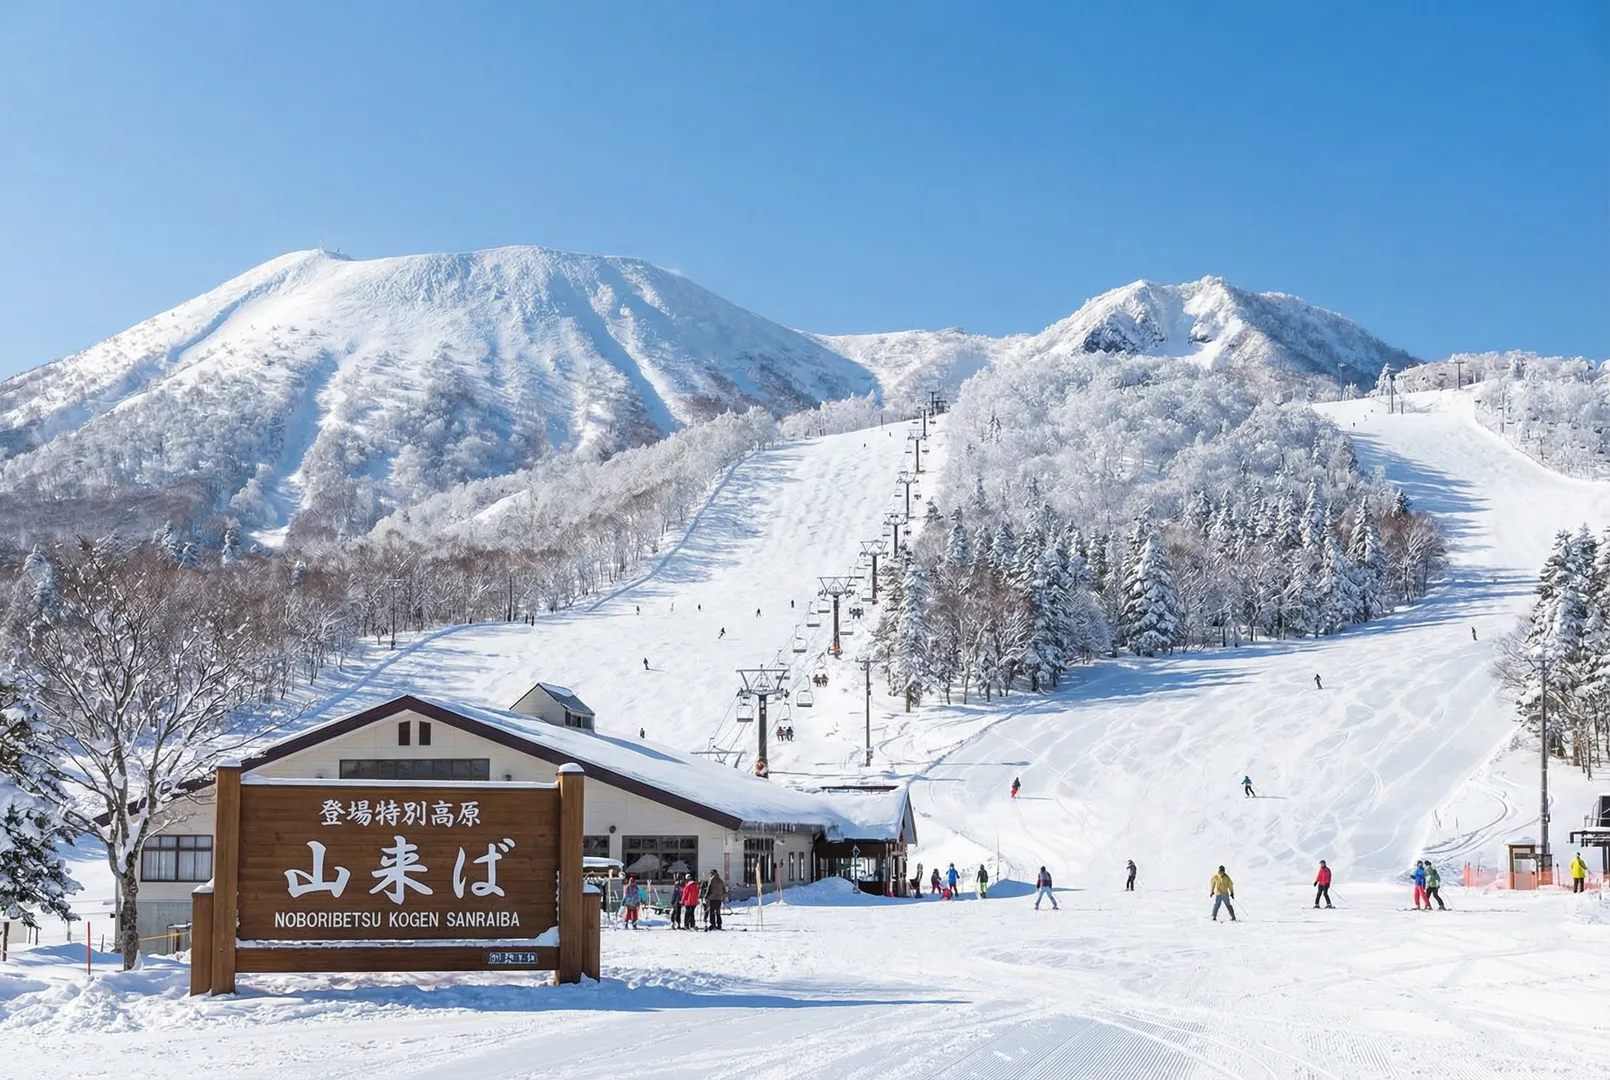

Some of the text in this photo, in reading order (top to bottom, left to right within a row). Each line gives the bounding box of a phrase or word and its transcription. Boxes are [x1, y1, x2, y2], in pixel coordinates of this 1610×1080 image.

[319, 799, 481, 828] 登場特別高原
[283, 835, 516, 905] 山来ば
[274, 911, 520, 928] NOBORIBETSU KOGEN SANRAIBA
